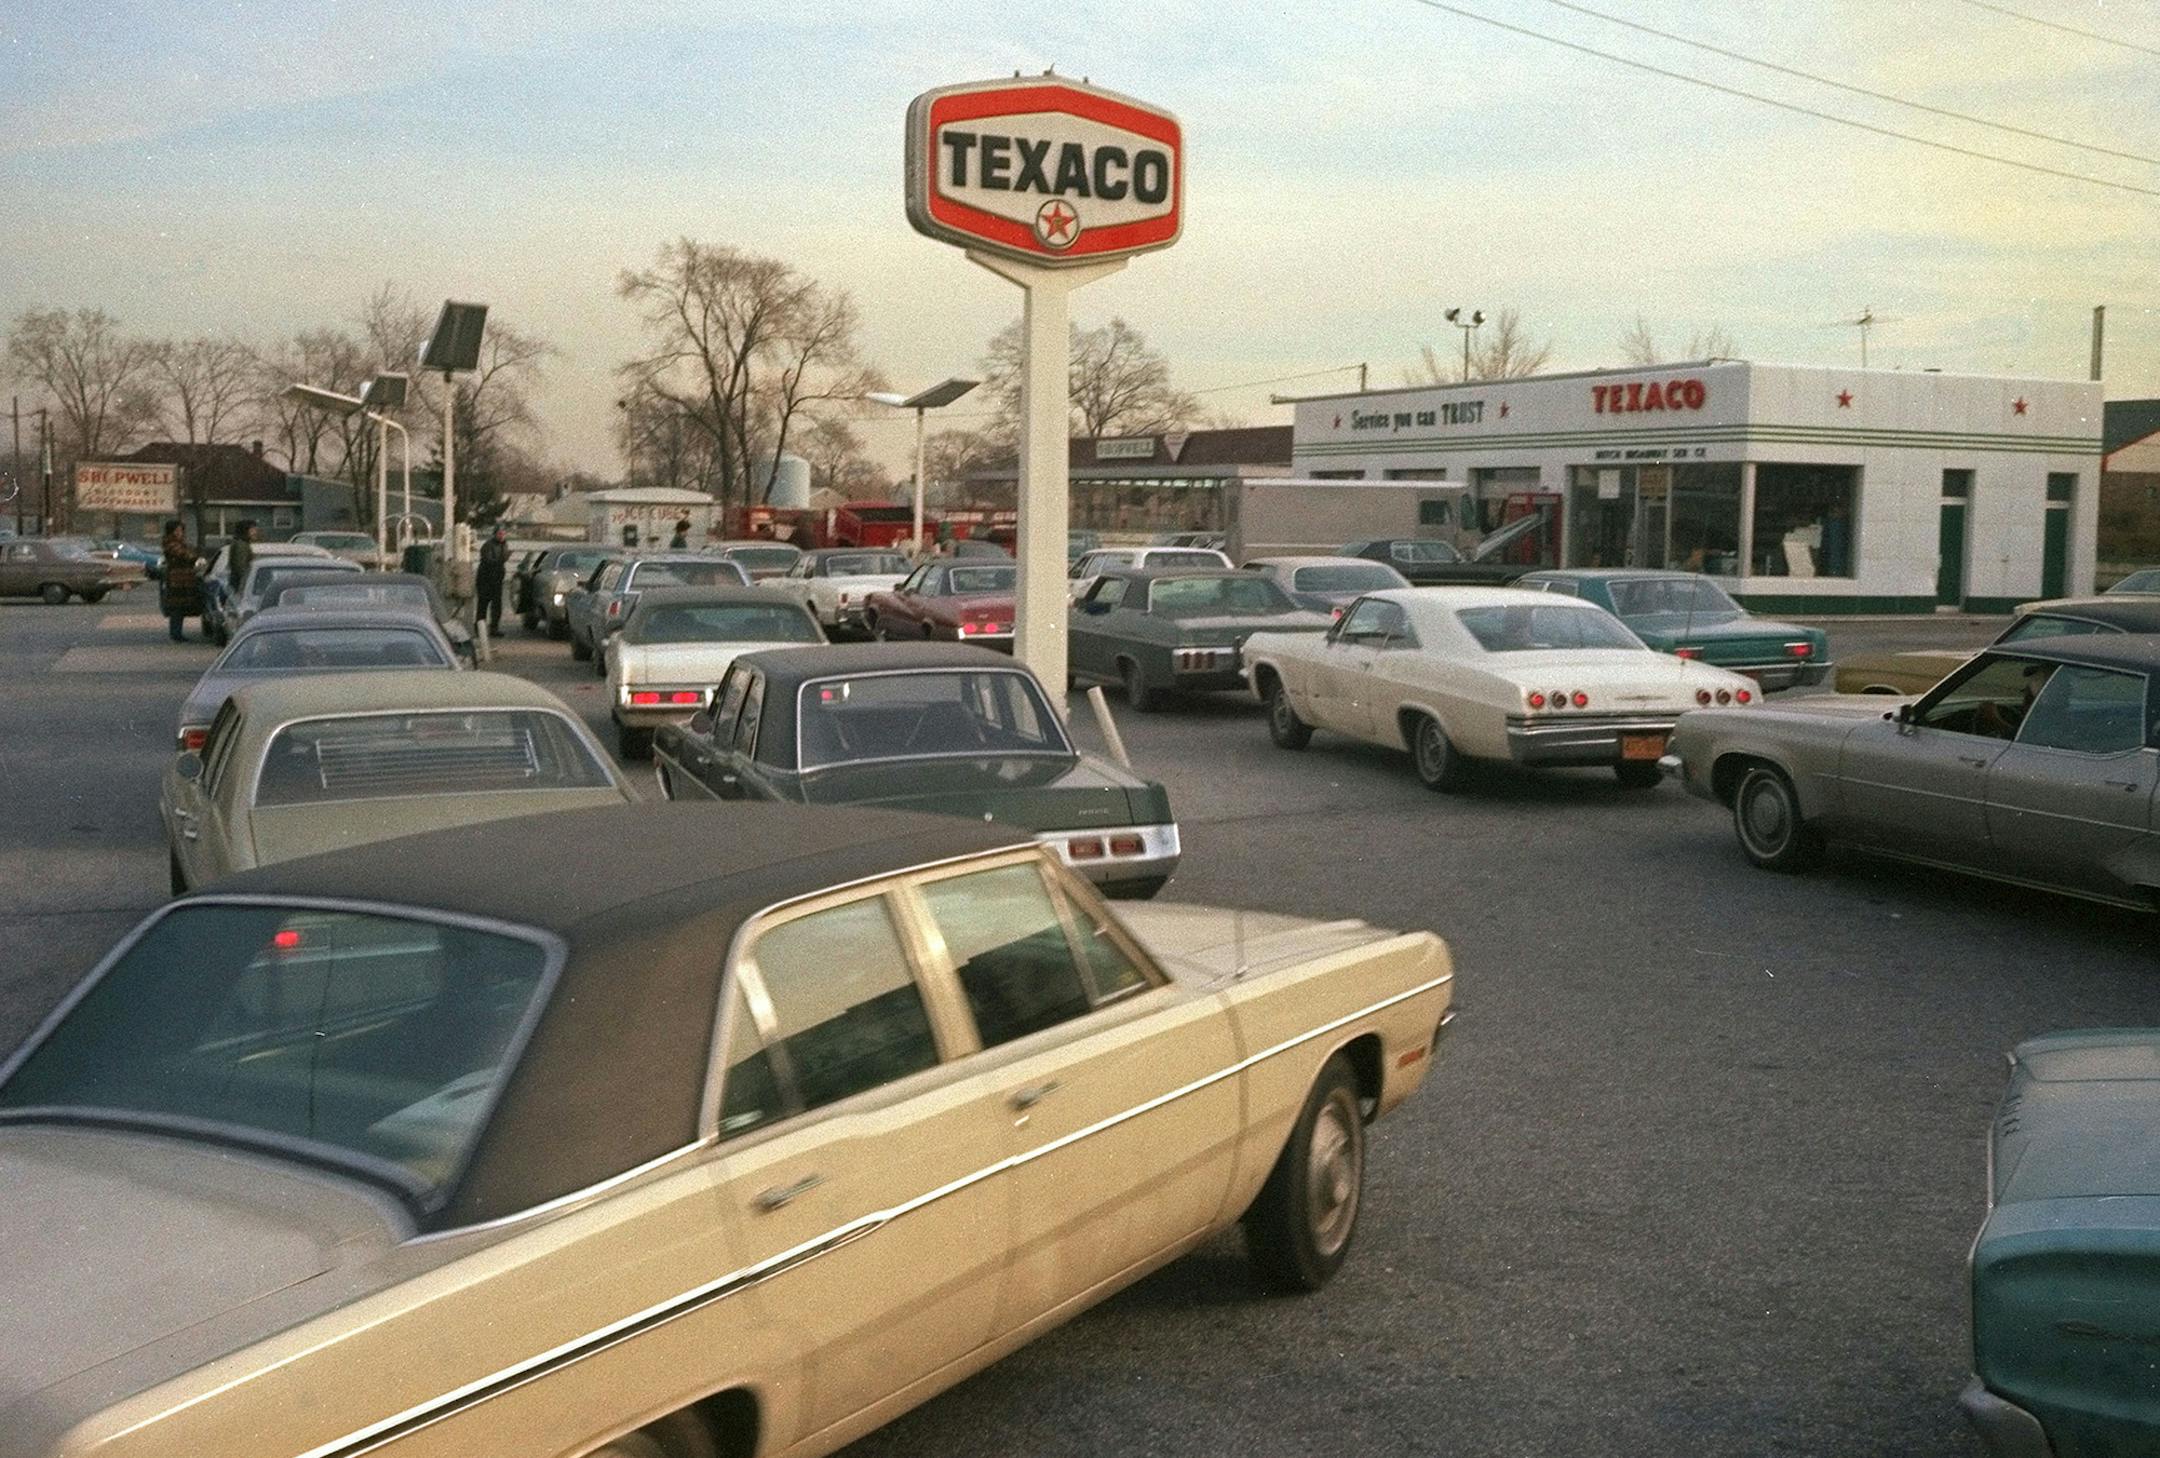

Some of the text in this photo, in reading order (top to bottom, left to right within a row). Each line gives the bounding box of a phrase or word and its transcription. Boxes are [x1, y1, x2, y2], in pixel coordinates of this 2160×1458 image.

[943, 130, 1168, 205] TEXACO
[1592, 379, 1705, 414] TEXACO
[1351, 400, 1484, 433] Service you can TRUST
